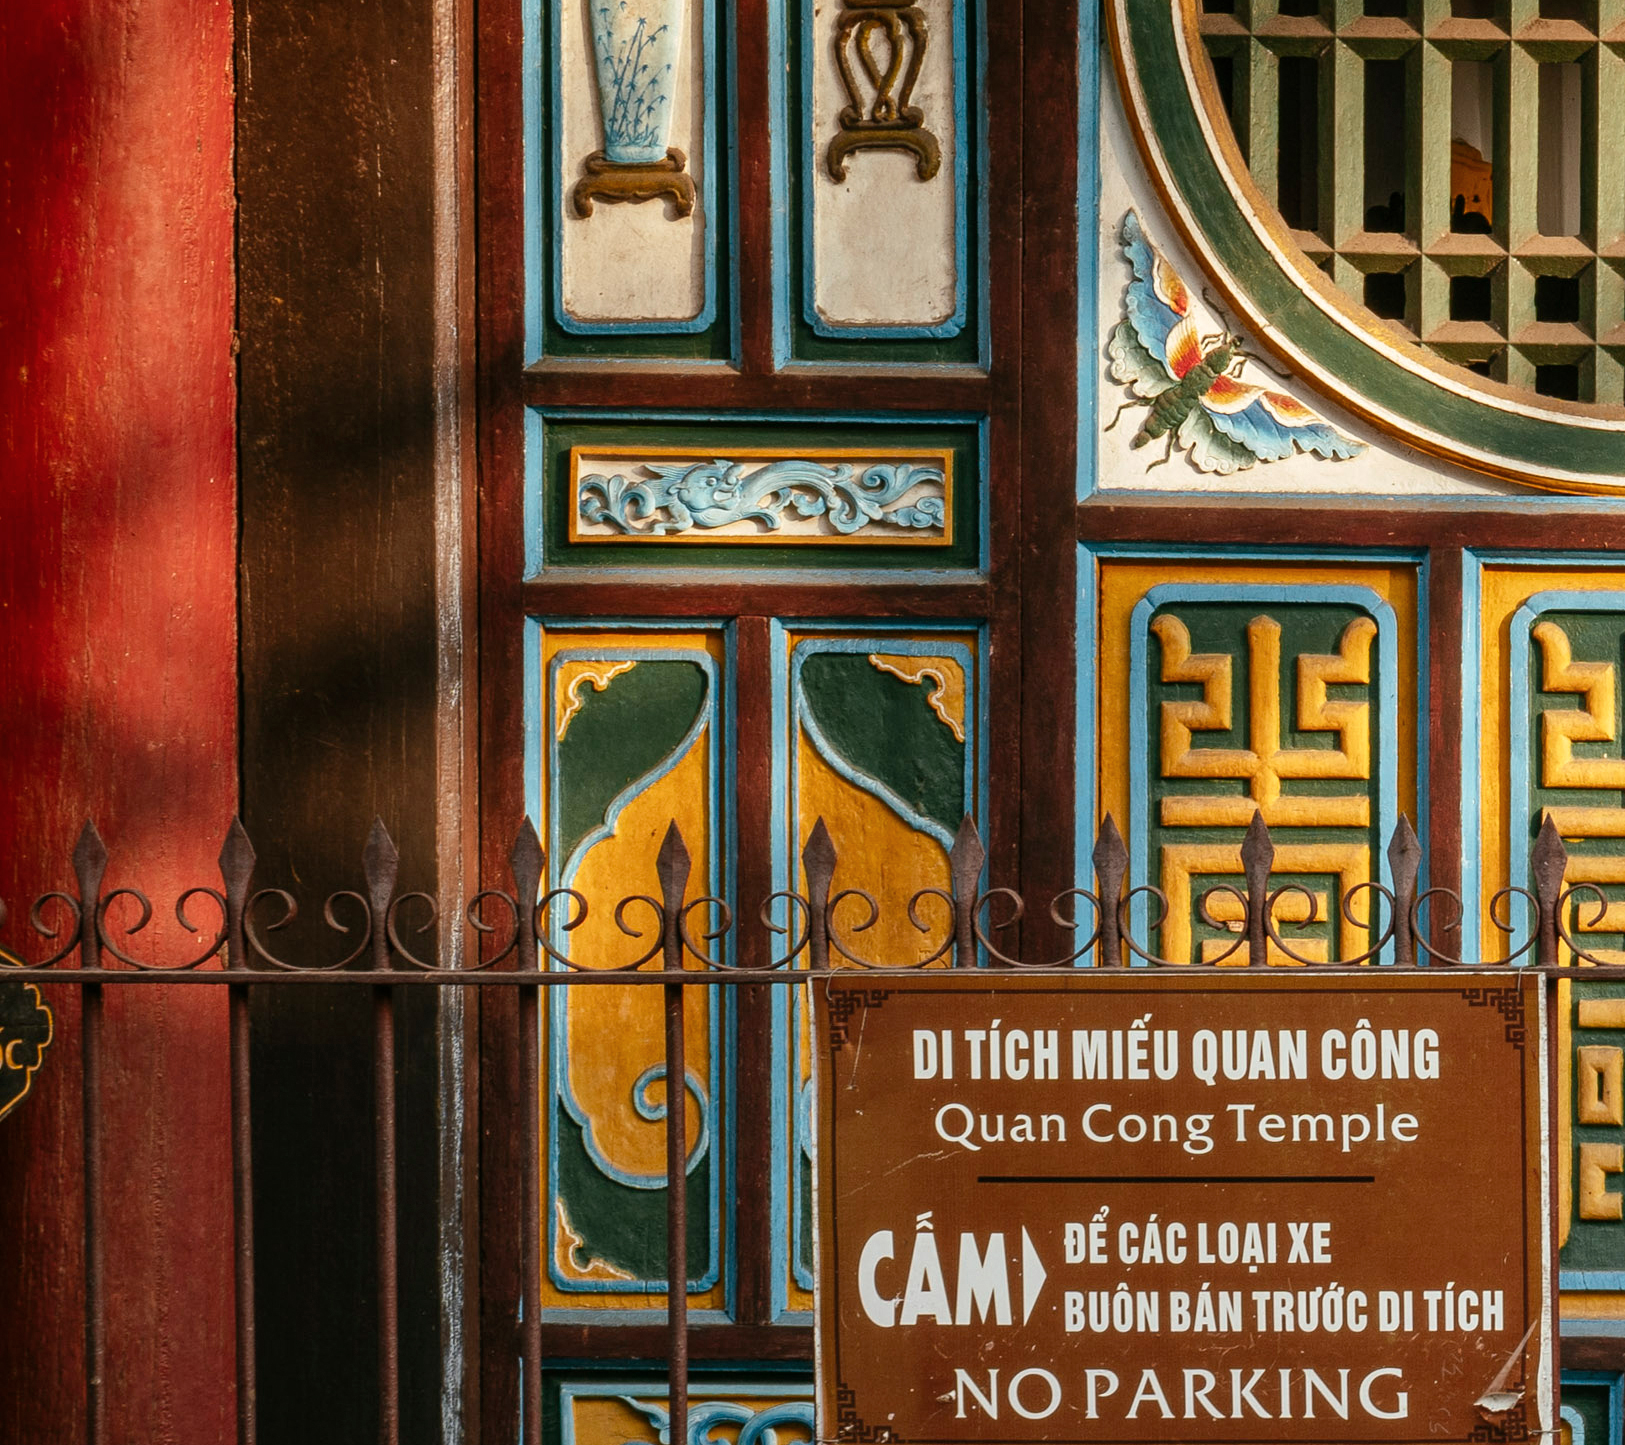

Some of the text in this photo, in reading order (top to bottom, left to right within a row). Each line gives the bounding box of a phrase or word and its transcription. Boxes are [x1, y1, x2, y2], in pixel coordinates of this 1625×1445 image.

[913, 1013, 1440, 1086] DI TÍCH MIẾU QUAN CÔNG
[935, 1103, 1419, 1155] Quan Cong Temple
[858, 1211, 1012, 1328] CẤM
[1063, 1205, 1332, 1274] ĐỂ CÁC LOẠI XE
[1064, 1281, 1505, 1333] BUÔN BÁN TRƯỚC DI TÍCH
[953, 1367, 1062, 1420] NO
[1084, 1367, 1410, 1421] PARKING
